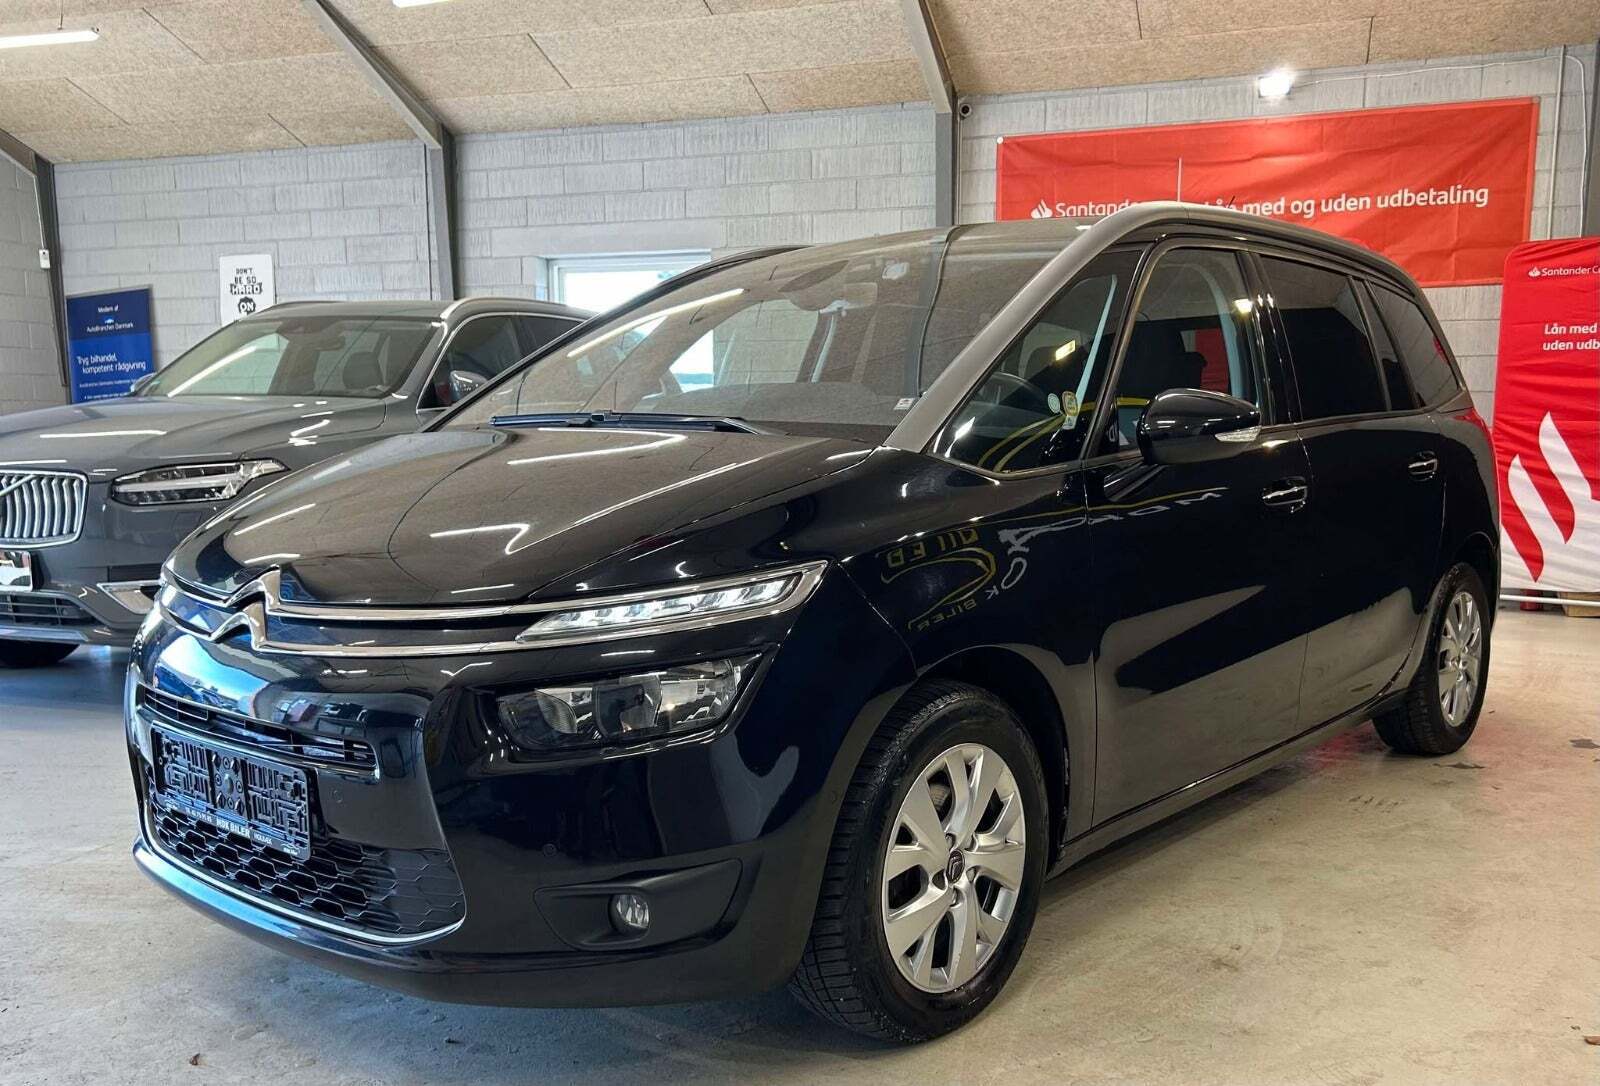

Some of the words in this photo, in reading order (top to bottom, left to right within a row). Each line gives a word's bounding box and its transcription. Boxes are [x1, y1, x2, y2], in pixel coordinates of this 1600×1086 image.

[1055, 199, 1131, 218] Santand
[1242, 197, 1285, 216] med
[1290, 199, 1315, 219] og
[1320, 193, 1371, 213] uden
[1377, 184, 1489, 208] udbetaling
[1541, 266, 1591, 276] Santander
[1544, 322, 1567, 335] Lån
[1569, 322, 1598, 334] med
[1542, 340, 1574, 351] uden
[1576, 338, 1600, 350] udb
[82, 364, 114, 375] kompetent
[115, 361, 146, 373] rådgivning
